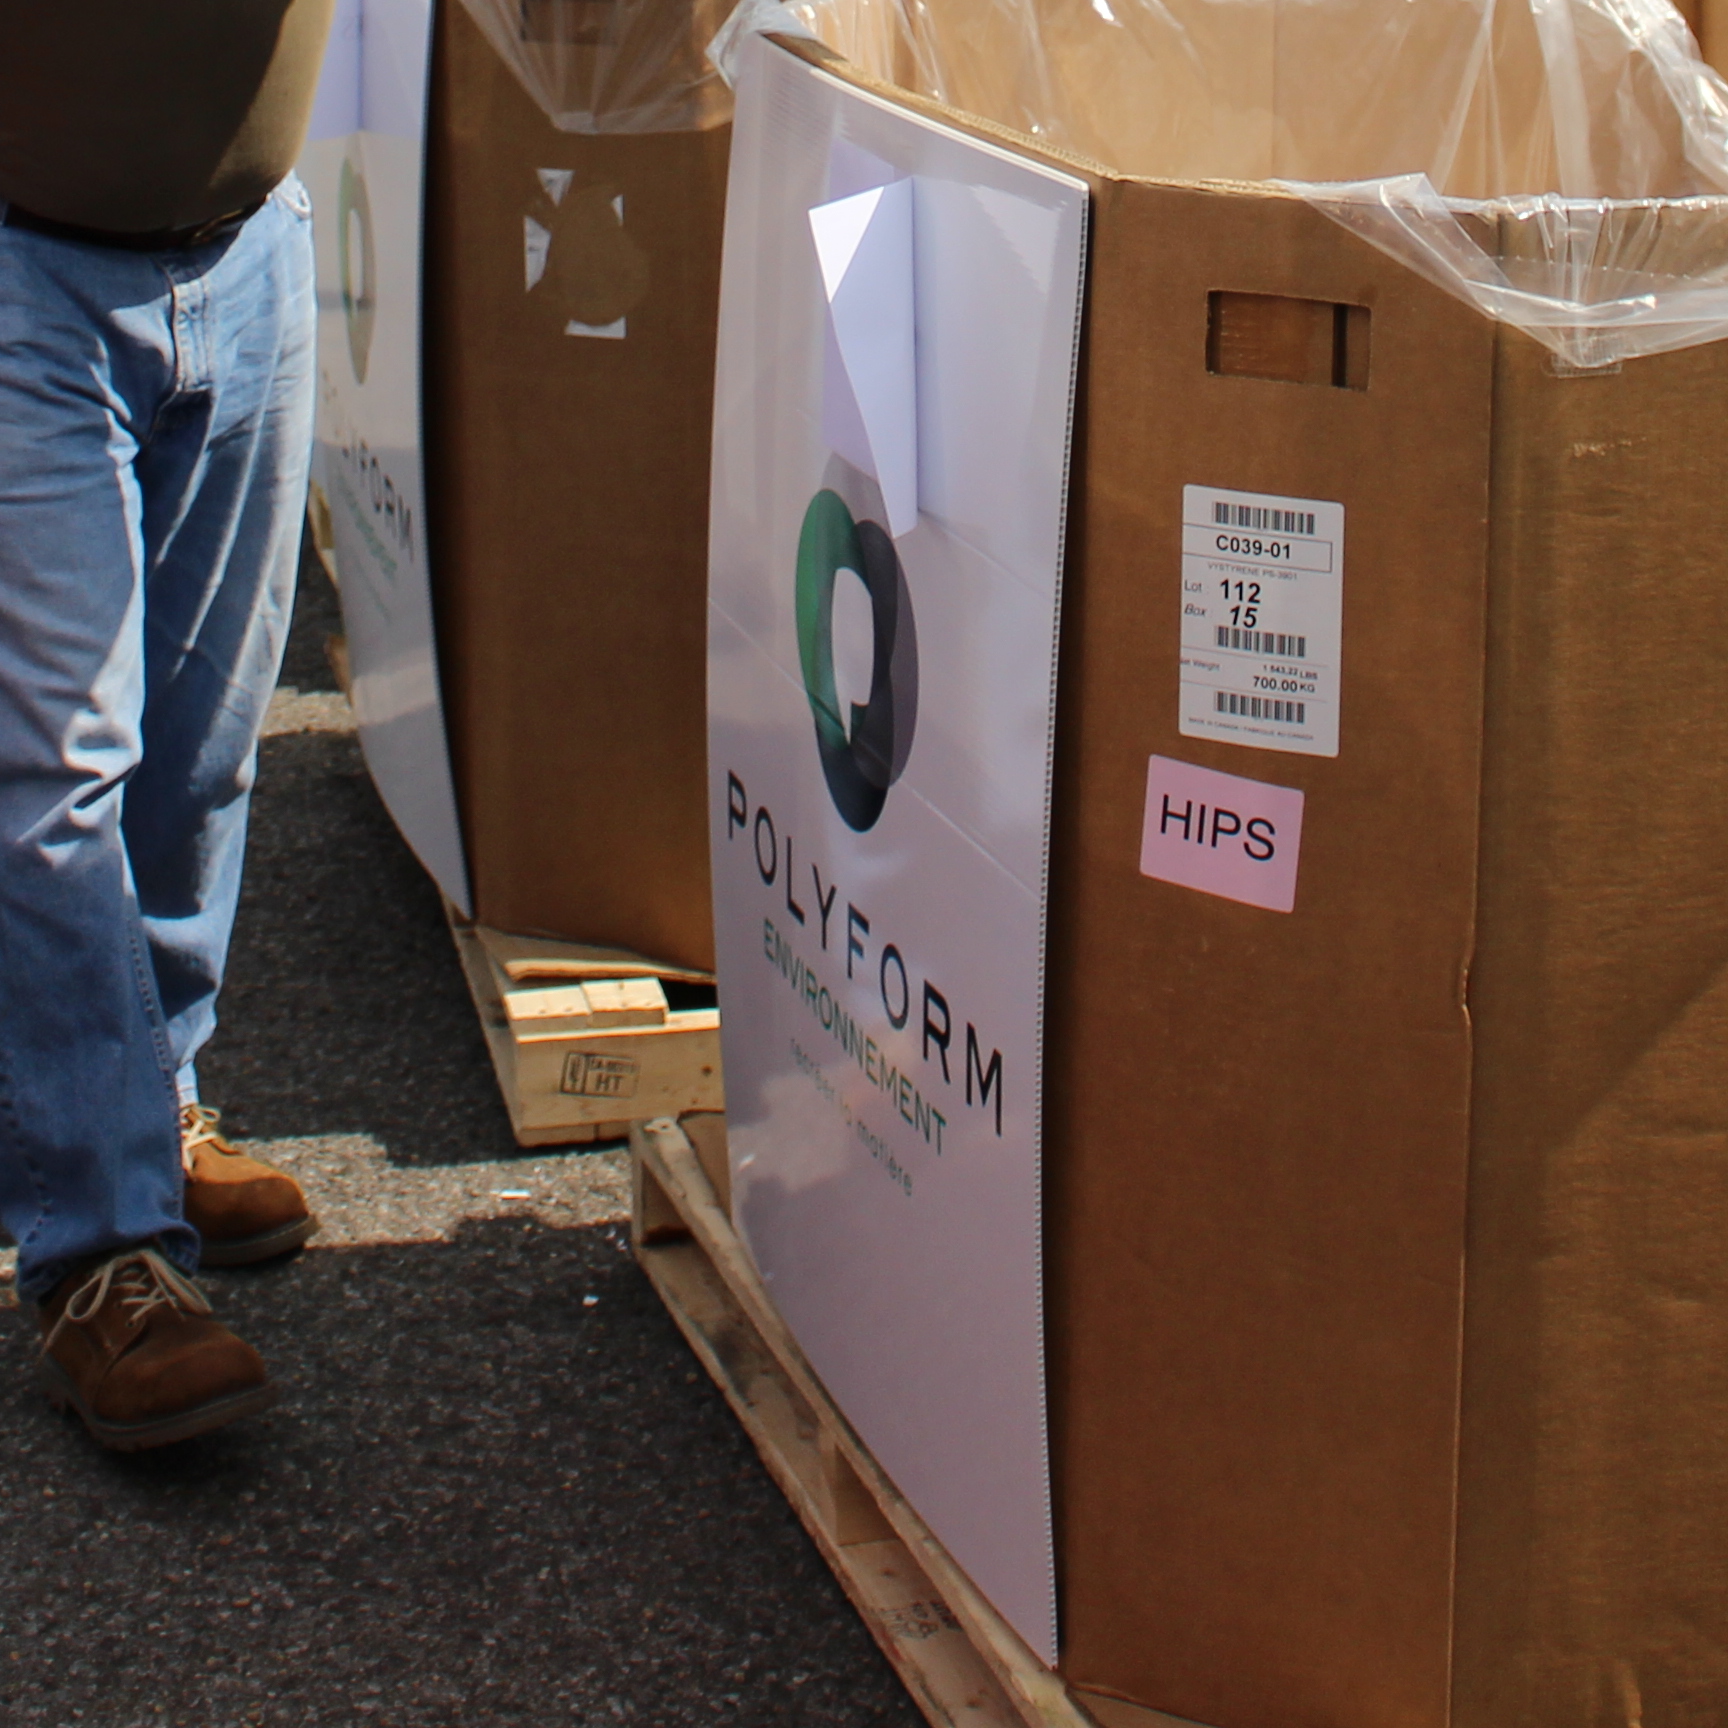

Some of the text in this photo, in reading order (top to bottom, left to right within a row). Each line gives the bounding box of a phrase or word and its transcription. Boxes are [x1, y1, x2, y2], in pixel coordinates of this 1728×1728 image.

[1216, 534, 1291, 559] C039-01
[1220, 578, 1261, 604] 112
[1184, 604, 1258, 629] Box 15
[1253, 675, 1316, 693] 700.00 KG
[1160, 793, 1276, 862] HIPS
[727, 769, 1003, 1138] POLYFORM
[764, 917, 947, 1157] ENVIRONNEMENT
